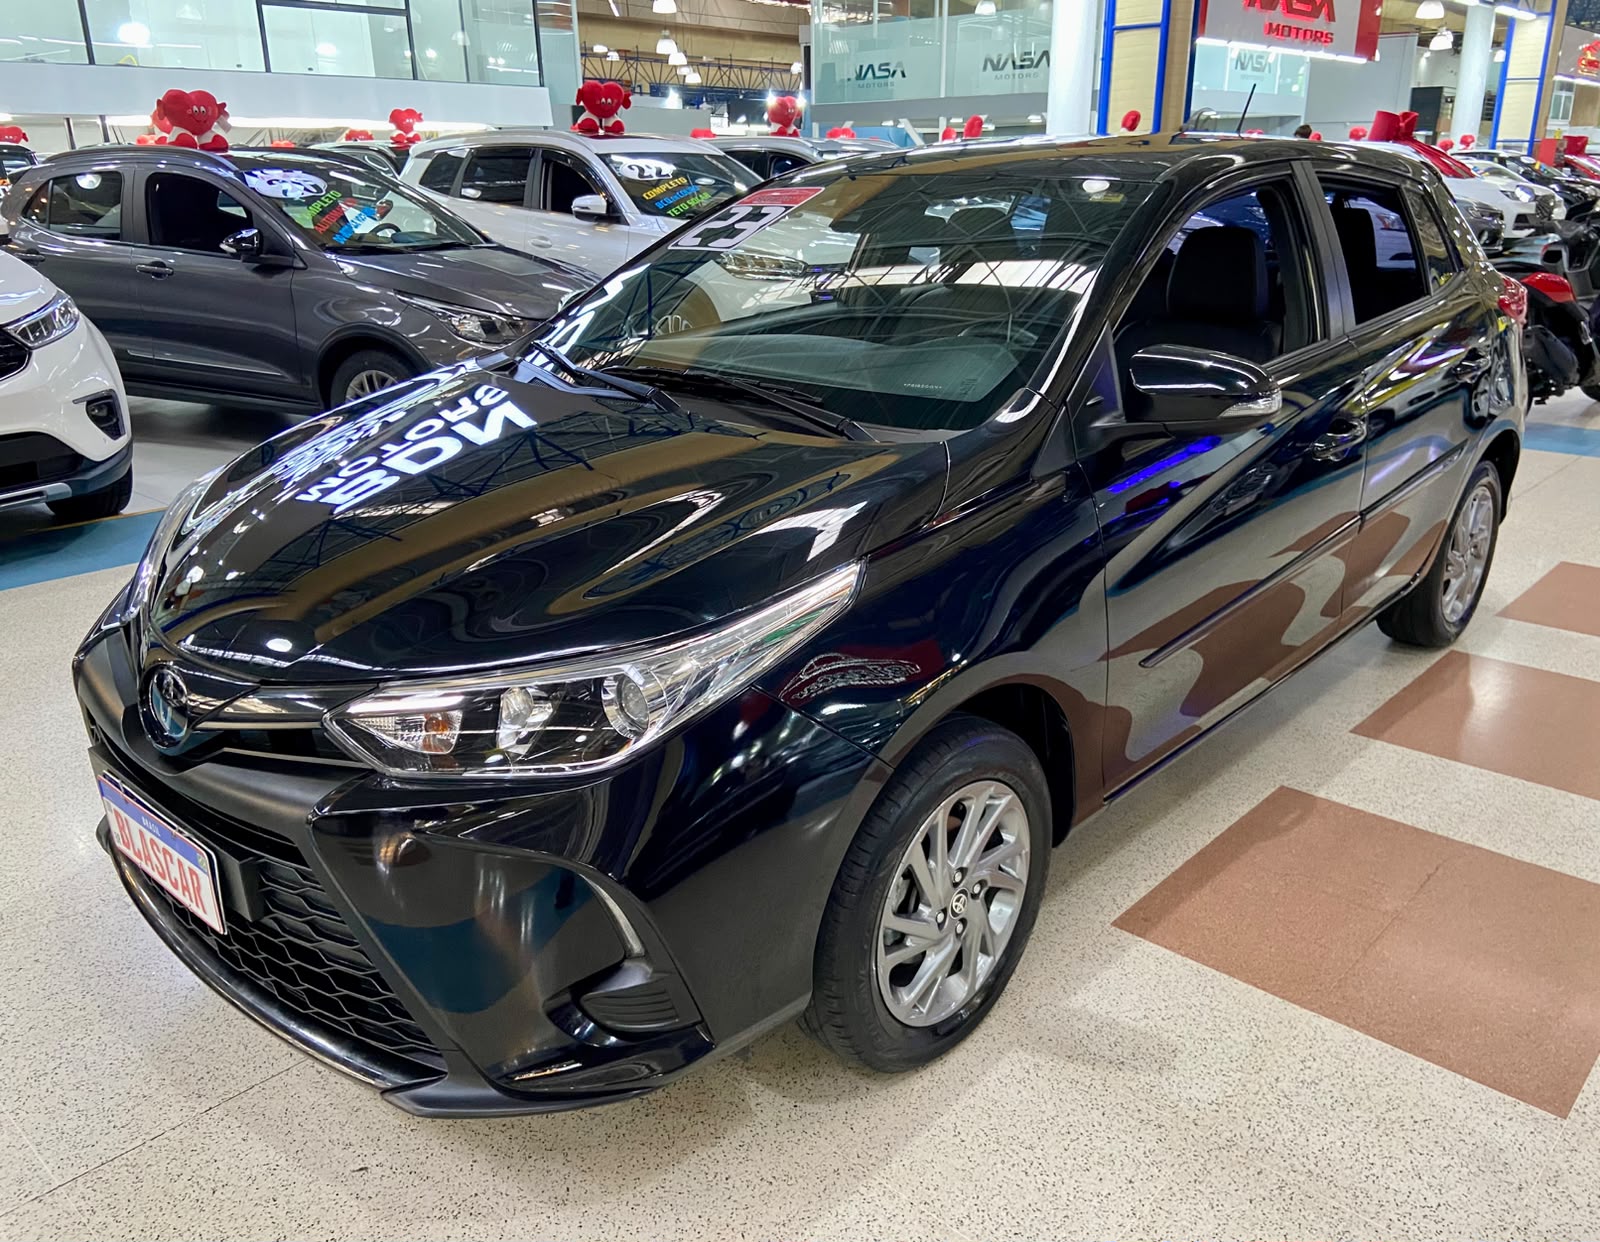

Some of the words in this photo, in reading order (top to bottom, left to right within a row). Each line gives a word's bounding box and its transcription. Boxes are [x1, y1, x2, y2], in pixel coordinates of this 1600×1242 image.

[1264, 22, 1334, 45] MOTORS
[982, 50, 1050, 72] NASA
[1235, 51, 1272, 73] NASA
[994, 72, 1039, 80] MOTORS
[627, 164, 671, 179] 22
[642, 176, 688, 200] COMPLETO
[303, 190, 342, 219] MPLETO
[666, 202, 689, 217] TETO
[678, 206, 786, 248] 23
[141, 816, 161, 837] BRASIL
[113, 808, 207, 915] BLASCAR
